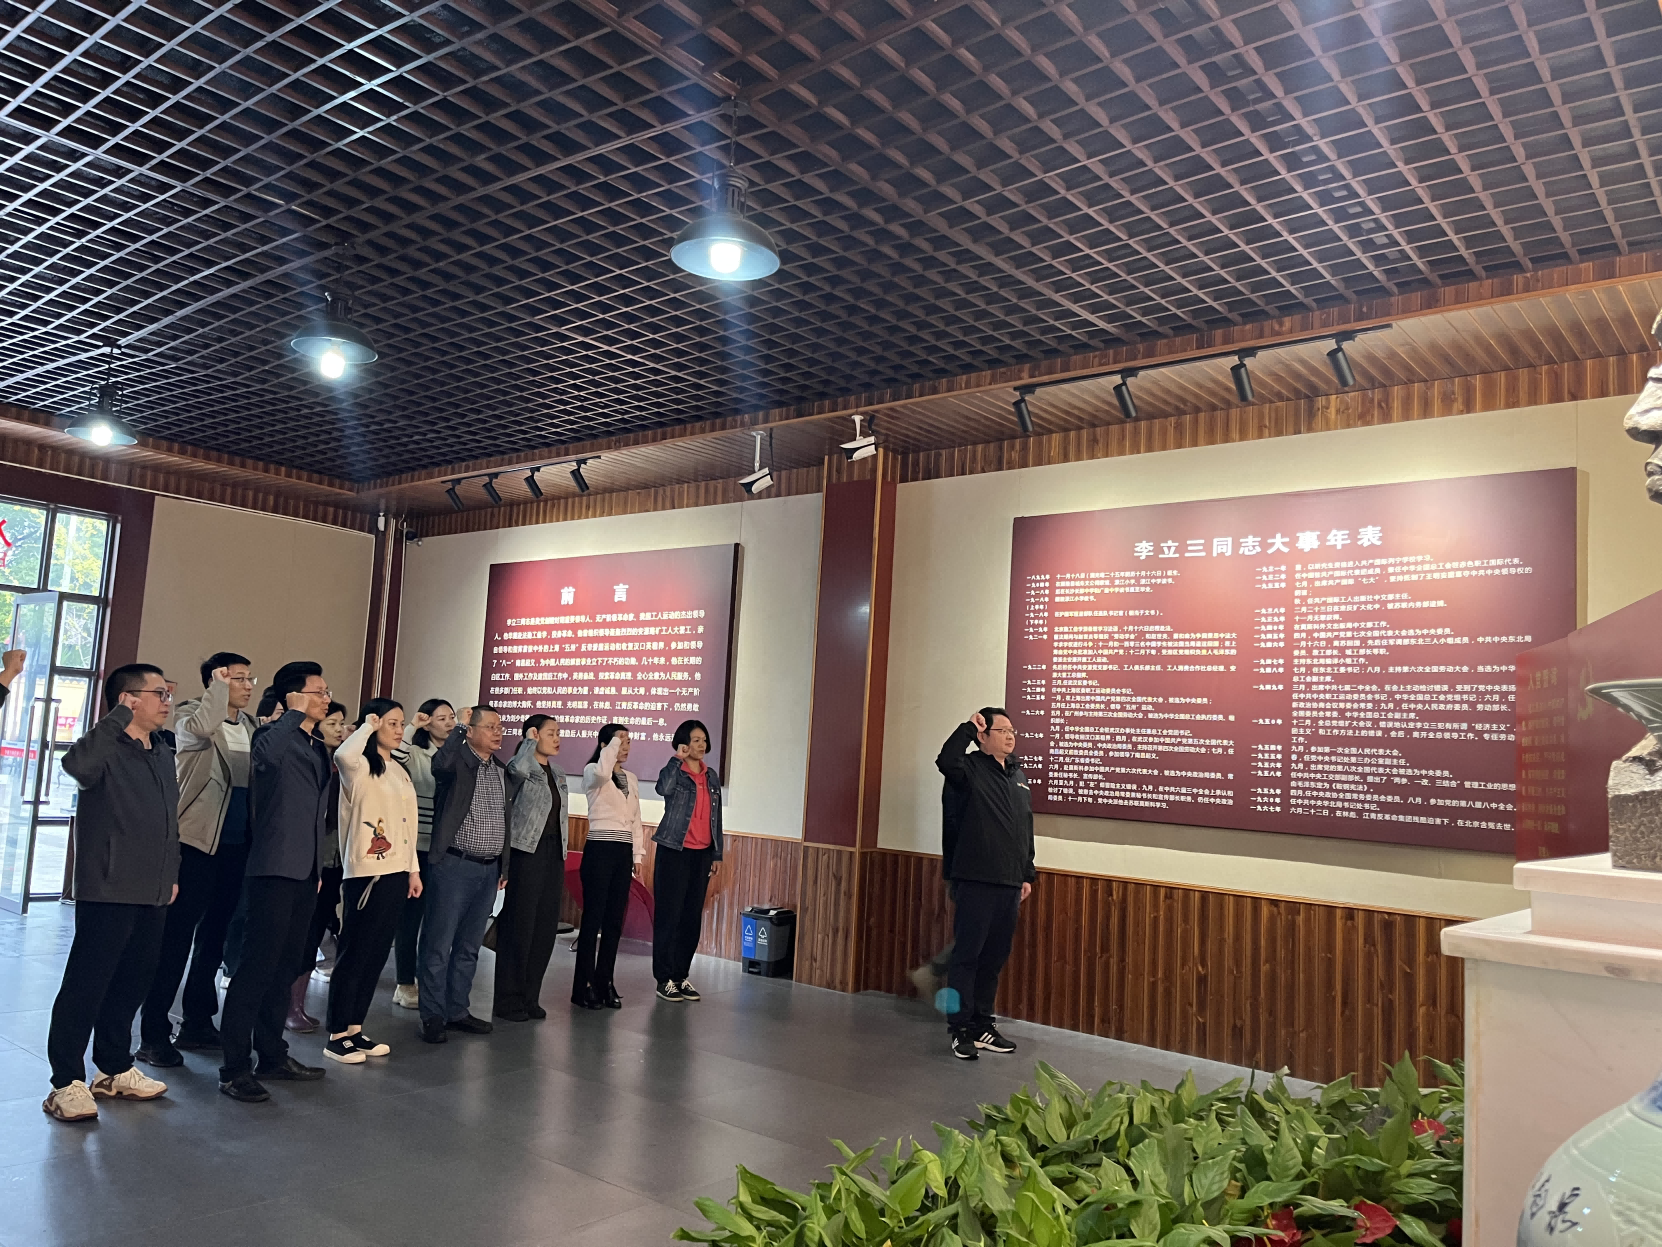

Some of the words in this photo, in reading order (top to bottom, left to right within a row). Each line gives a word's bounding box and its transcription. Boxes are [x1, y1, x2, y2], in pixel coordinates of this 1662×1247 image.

[1133, 525, 1383, 560] 李立三同志大事年表
